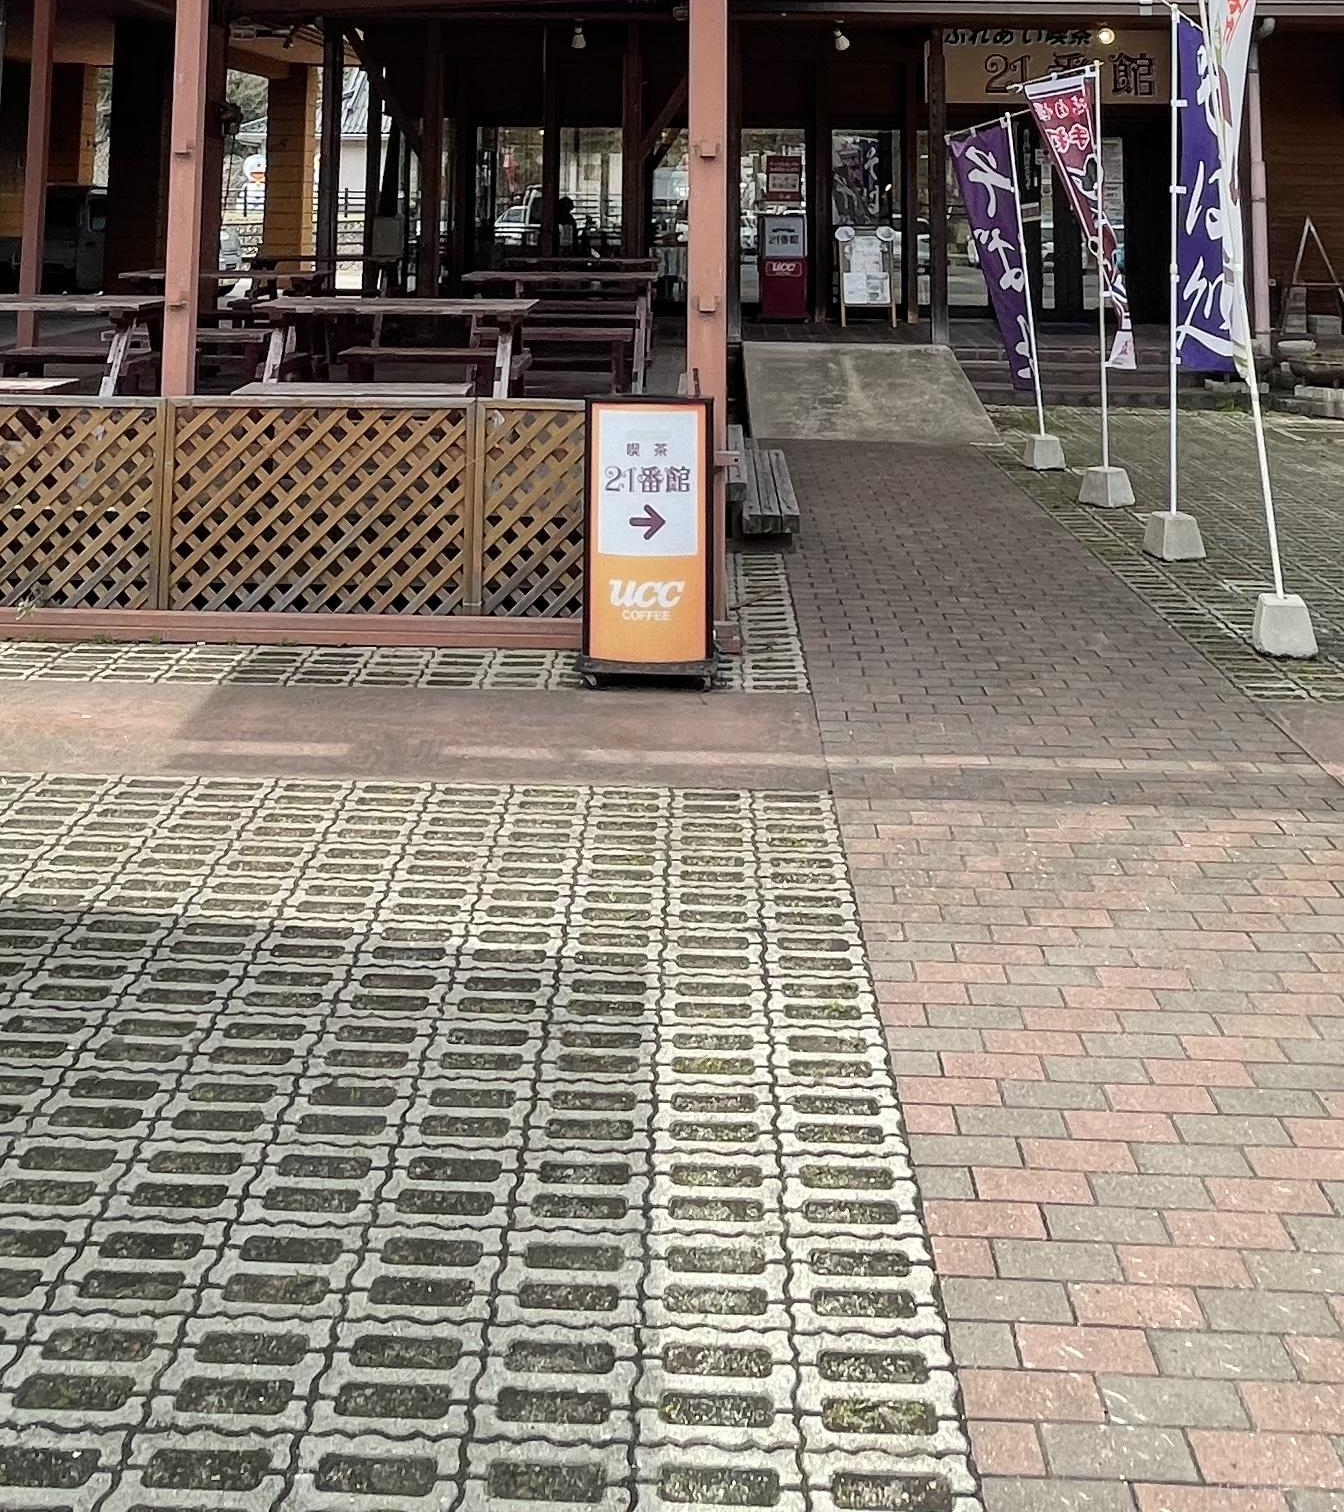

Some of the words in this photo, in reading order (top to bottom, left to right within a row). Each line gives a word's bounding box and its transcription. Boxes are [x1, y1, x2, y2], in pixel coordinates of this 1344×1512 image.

[626, 442, 668, 457] 喫茶
[605, 465, 690, 493] 21番館
[609, 580, 685, 608] UCC
[622, 609, 671, 621] COFFEE
